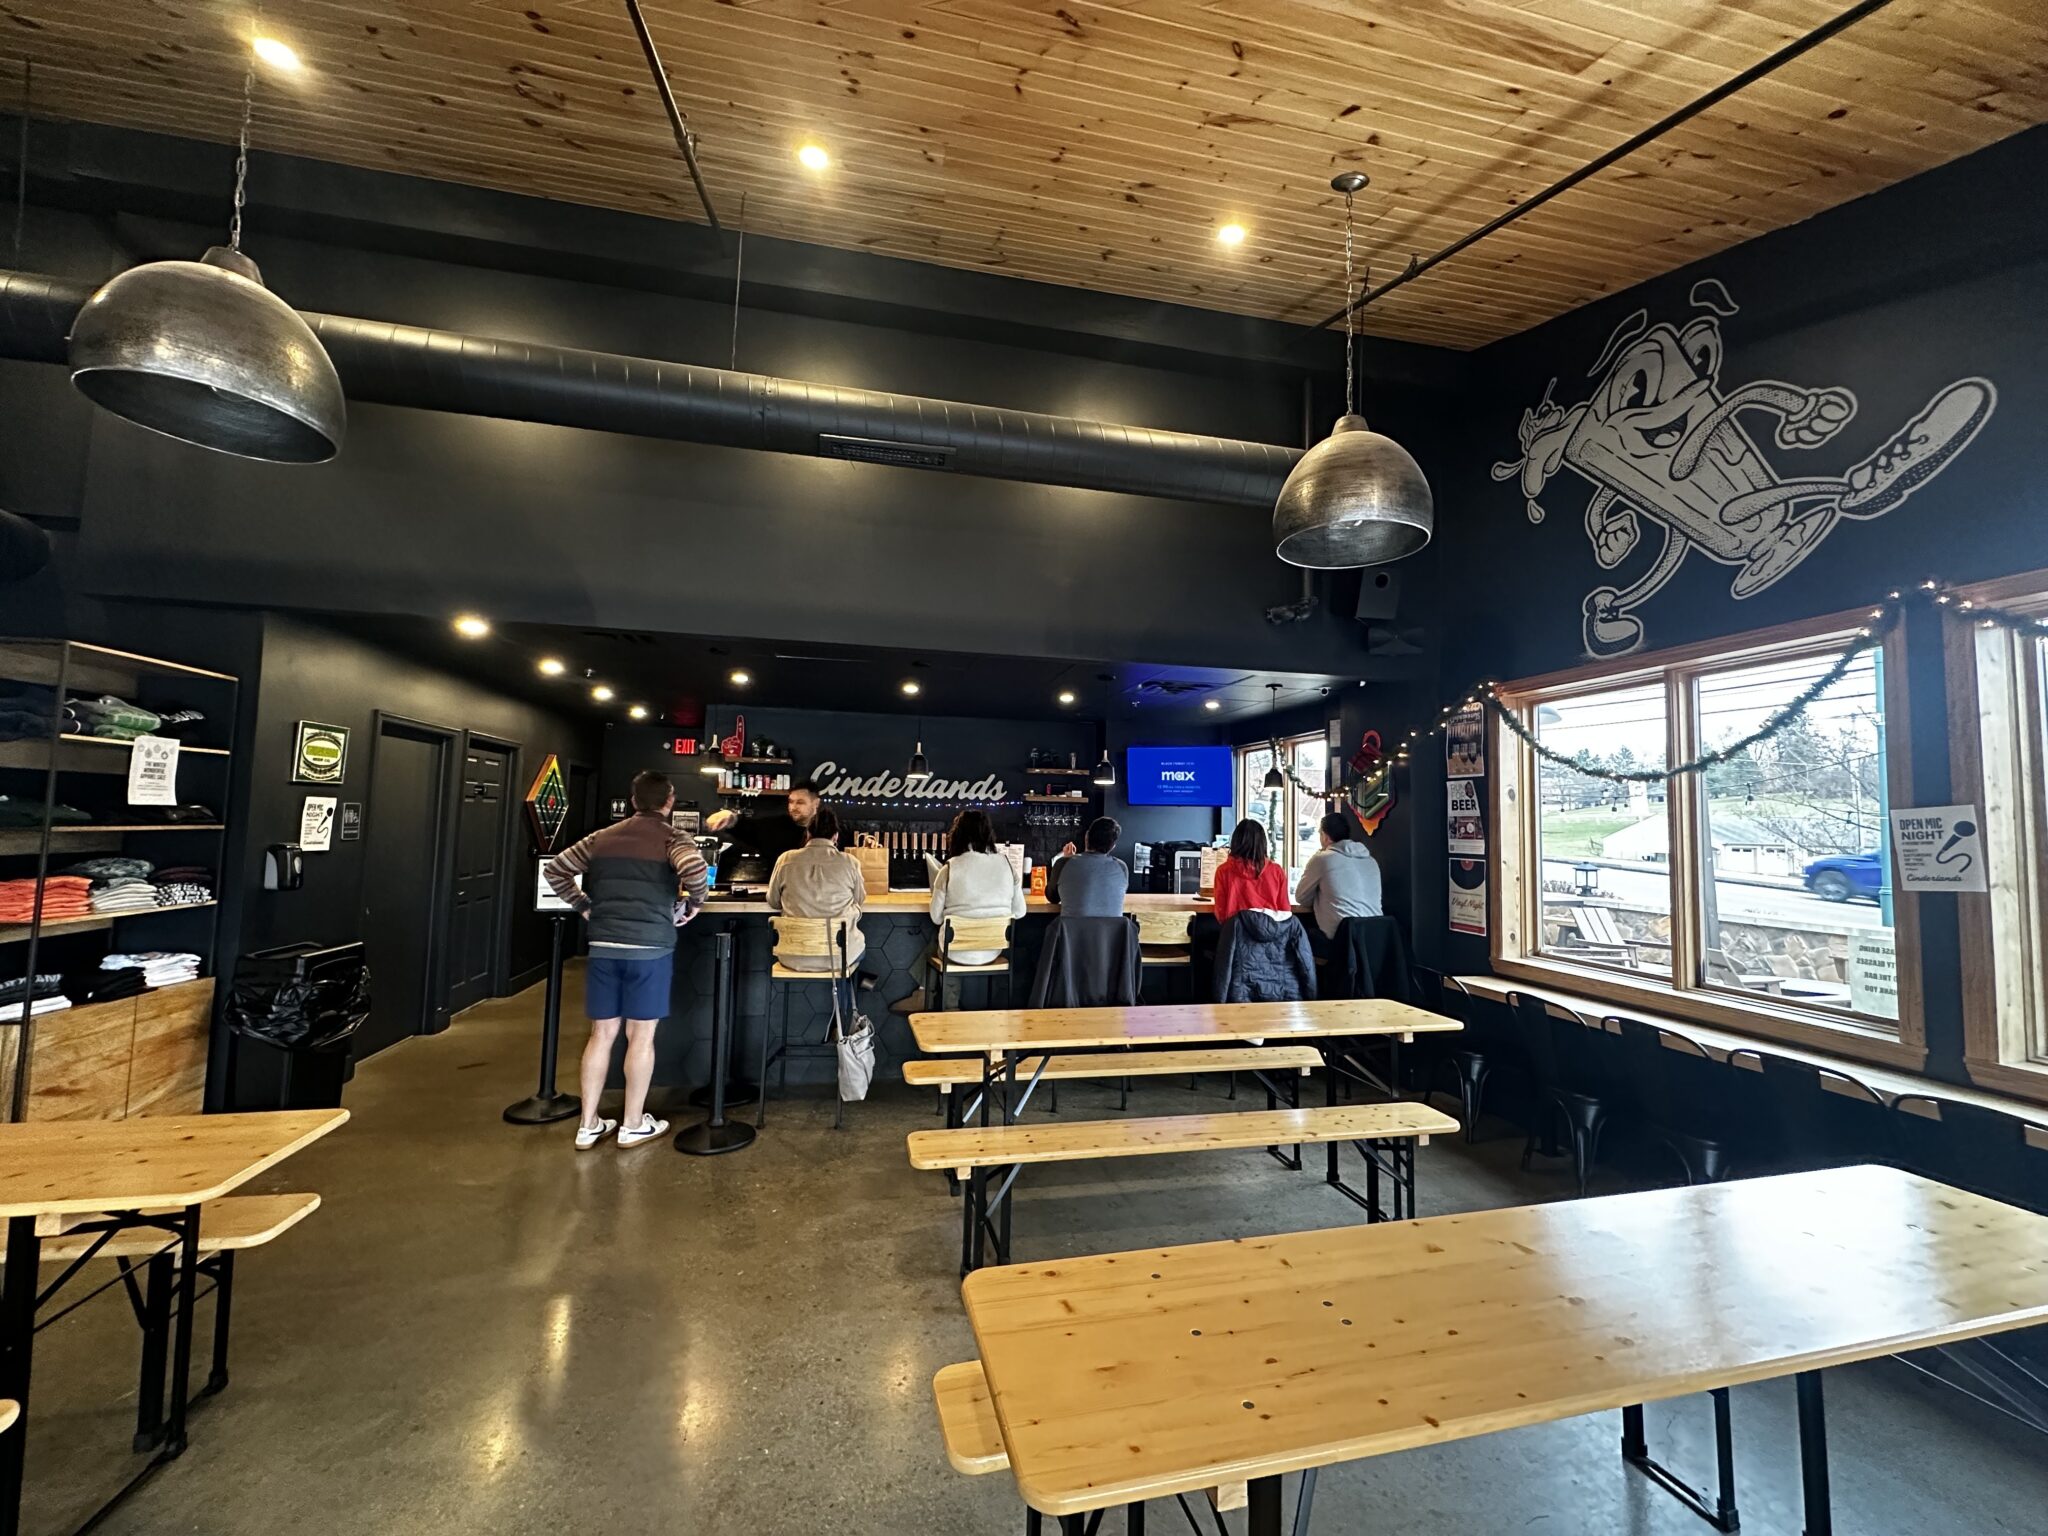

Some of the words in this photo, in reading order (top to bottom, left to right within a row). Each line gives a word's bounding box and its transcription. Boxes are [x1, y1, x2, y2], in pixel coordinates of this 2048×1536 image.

[675, 738, 696, 754] EXIT
[810, 761, 1008, 801] Cinderlands
[1161, 771, 1195, 781] max
[1451, 799, 1477, 811] BEER
[1899, 818, 1924, 831] OPEN
[1925, 817, 1943, 830] MIC
[1901, 829, 1945, 840] NIGHT
